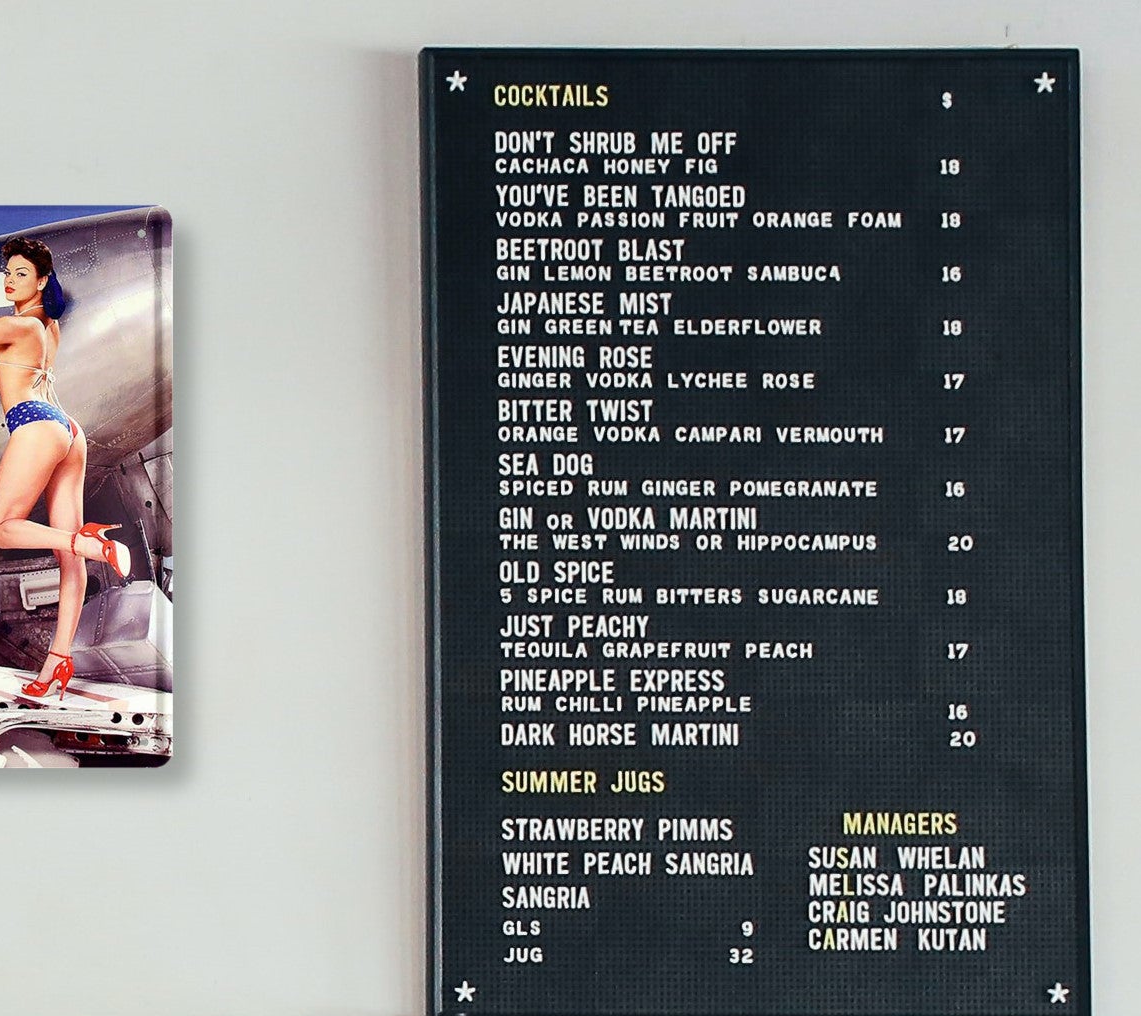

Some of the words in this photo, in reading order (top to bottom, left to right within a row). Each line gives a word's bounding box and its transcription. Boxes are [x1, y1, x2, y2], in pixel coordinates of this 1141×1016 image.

[494, 84, 609, 107] COCKTAILS
[494, 130, 555, 154] DON'T
[569, 131, 636, 155] SHRUB
[651, 131, 683, 155] ME
[697, 131, 737, 155] OFF
[495, 157, 589, 174] CACHACA
[603, 158, 671, 175] HONEY
[685, 158, 718, 175] FIG
[940, 158, 960, 175] 18
[495, 183, 569, 208] YOU'VE
[583, 184, 637, 208] BEEN
[650, 184, 746, 208] TANGOED
[495, 211, 563, 228] VODKA
[577, 211, 665, 228] PASSION
[679, 212, 739, 228] FRUIT
[752, 211, 833, 228] ORANGE
[848, 211, 902, 229] FOAM
[941, 212, 961, 229] 18
[496, 238, 604, 262] BEETROOT
[618, 238, 685, 262] BLAST
[496, 265, 530, 282] GIN
[544, 265, 612, 282] LEMON
[625, 265, 733, 282] BEETROOT
[941, 266, 962, 282] 16
[496, 291, 604, 315] JAPANESE
[619, 292, 672, 316] MIST
[497, 318, 531, 335] GIN
[544, 318, 613, 336] GREEN
[618, 319, 659, 336] TEA
[673, 319, 822, 336] ELDERFLOWER
[943, 319, 962, 336] 18
[497, 345, 585, 369] EVENING
[599, 345, 653, 370] ROSE
[497, 372, 572, 389] GINGER
[585, 372, 653, 389] VODKA
[667, 372, 748, 389] LYCHEE
[762, 372, 815, 390] ROSE
[943, 373, 965, 390] 17
[498, 399, 573, 423] BITTER
[585, 399, 653, 423] TWIST
[497, 426, 578, 443] ORANGE
[593, 426, 660, 443] VODKA
[674, 426, 762, 443] CAMPARI
[776, 426, 883, 444] VERMOUTH
[944, 427, 966, 444] 17
[498, 453, 539, 476] SEA
[553, 453, 594, 476] DOG
[499, 479, 574, 497] SPICED
[587, 480, 628, 497] RUM
[641, 479, 716, 497] GINGER
[729, 480, 877, 498] POMEGRANATE
[945, 481, 965, 498] 16
[499, 506, 533, 530] GIN
[546, 513, 574, 531] OR
[587, 506, 656, 530] VODKA
[669, 506, 757, 531] MARTINI
[499, 533, 539, 550] THE
[552, 534, 608, 551] WEST
[619, 533, 680, 550] WINDS
[695, 534, 723, 551] OR
[737, 534, 877, 552] HIPPOCAMPUS
[947, 535, 974, 552] 20
[499, 560, 540, 584] OLD
[553, 560, 614, 584] SPICE
[499, 587, 512, 604] 5
[527, 587, 587, 604] SPICE
[602, 587, 643, 605] RUM
[656, 587, 742, 605] BITTERS
[758, 588, 879, 606] SUGARCANE
[947, 588, 967, 605] 18
[499, 614, 554, 638] JUST
[568, 614, 649, 638] PEACHY
[500, 641, 588, 659] TEQUILA
[602, 641, 731, 659] GRAPEFRUIT
[745, 642, 813, 659] PEACH
[947, 643, 969, 660] 17
[500, 668, 616, 692] PINEAPPLE
[630, 669, 725, 693] EXPRESS
[501, 695, 542, 712] RUM
[555, 696, 622, 713] CHILLI
[637, 696, 752, 713] PINEAPPLE
[948, 703, 968, 721] 16
[501, 723, 555, 747] DARK
[569, 722, 637, 746] HORSE
[651, 722, 739, 747] MARTINI
[949, 730, 976, 748] 20
[501, 770, 597, 794] SUMMER
[610, 770, 665, 793] JUGS
[501, 818, 644, 842] STRAWBERRY
[658, 818, 733, 842] PIMMS
[843, 812, 958, 836] MANAGERS
[502, 851, 570, 876] WHITE
[583, 851, 652, 876] PEACH
[665, 852, 754, 876] SANGRIA
[808, 846, 877, 870] SUSAN
[897, 846, 985, 870] WHELAN
[809, 873, 904, 897] MELISSA
[924, 873, 1026, 897] PALINKAS
[502, 885, 591, 910] SANGRIA
[808, 900, 870, 924] CRAIG
[883, 900, 1006, 924] JOHNSTONE
[502, 920, 541, 936] GLS
[741, 920, 754, 937] 9
[808, 927, 898, 951] CARMEN
[918, 927, 986, 952] KUTAN
[503, 946, 543, 963] JUG
[729, 947, 754, 964] 32
